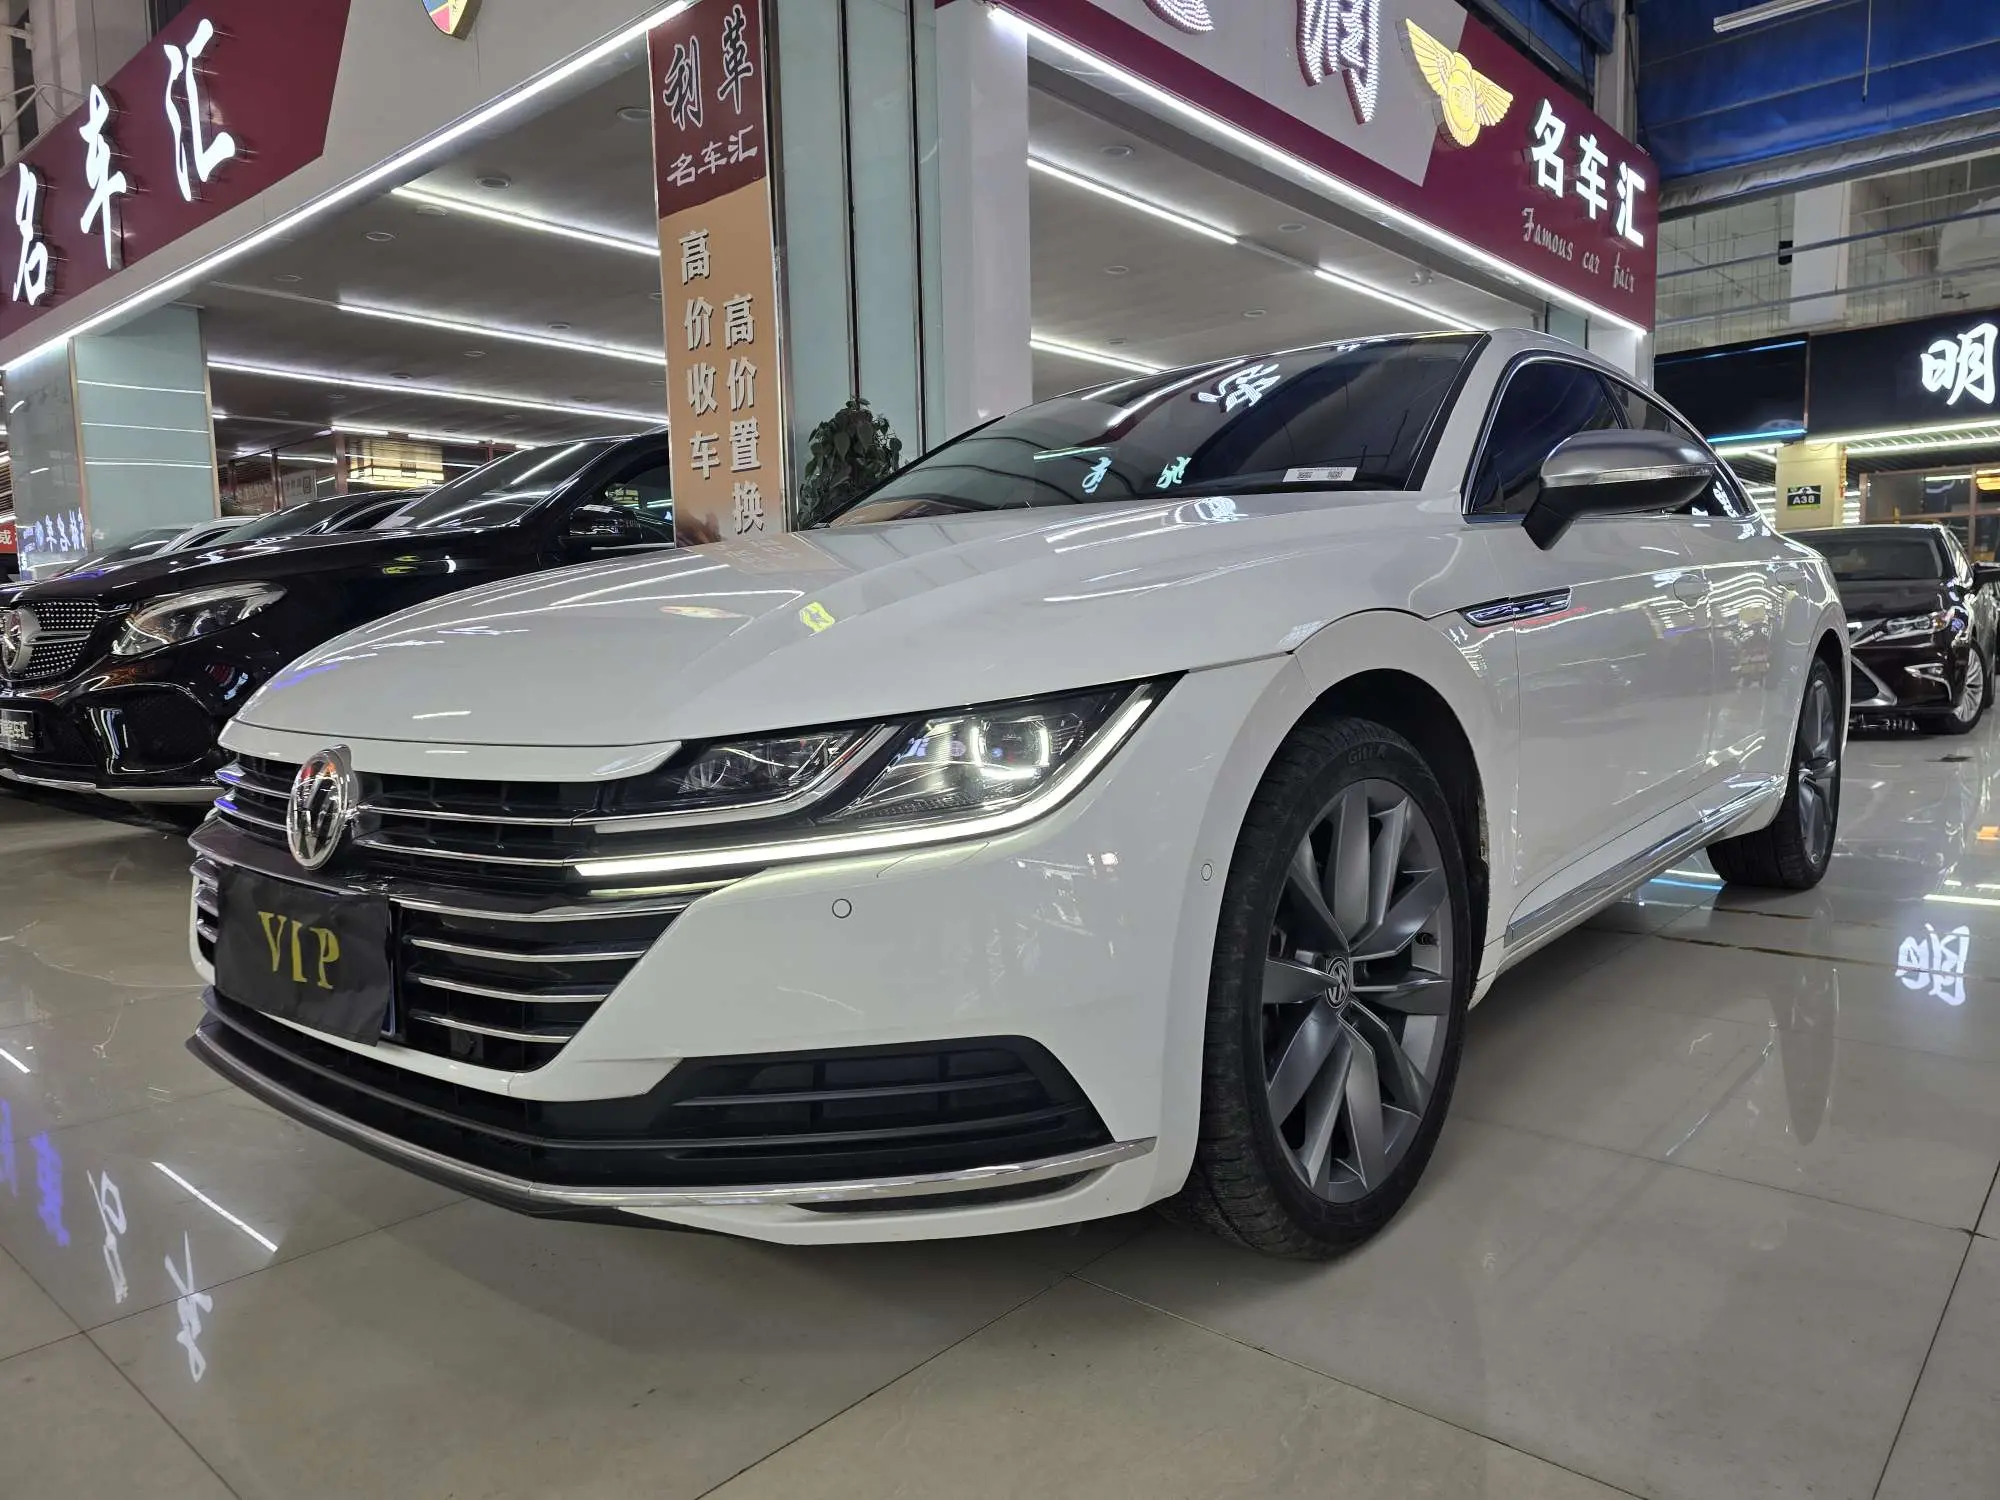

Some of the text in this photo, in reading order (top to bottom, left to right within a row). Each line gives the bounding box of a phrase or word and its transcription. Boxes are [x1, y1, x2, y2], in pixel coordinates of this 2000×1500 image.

[13, 18, 236, 306] 名车汇
[667, 124, 758, 188] 名车汇
[1531, 98, 1646, 248] 名车汇
[1521, 207, 1574, 261] Famous
[1583, 251, 1600, 274] car
[678, 229, 720, 480] 高价收车
[1920, 323, 1998, 405] 明
[723, 293, 765, 535] 高价置换
[258, 911, 340, 990] VIP
